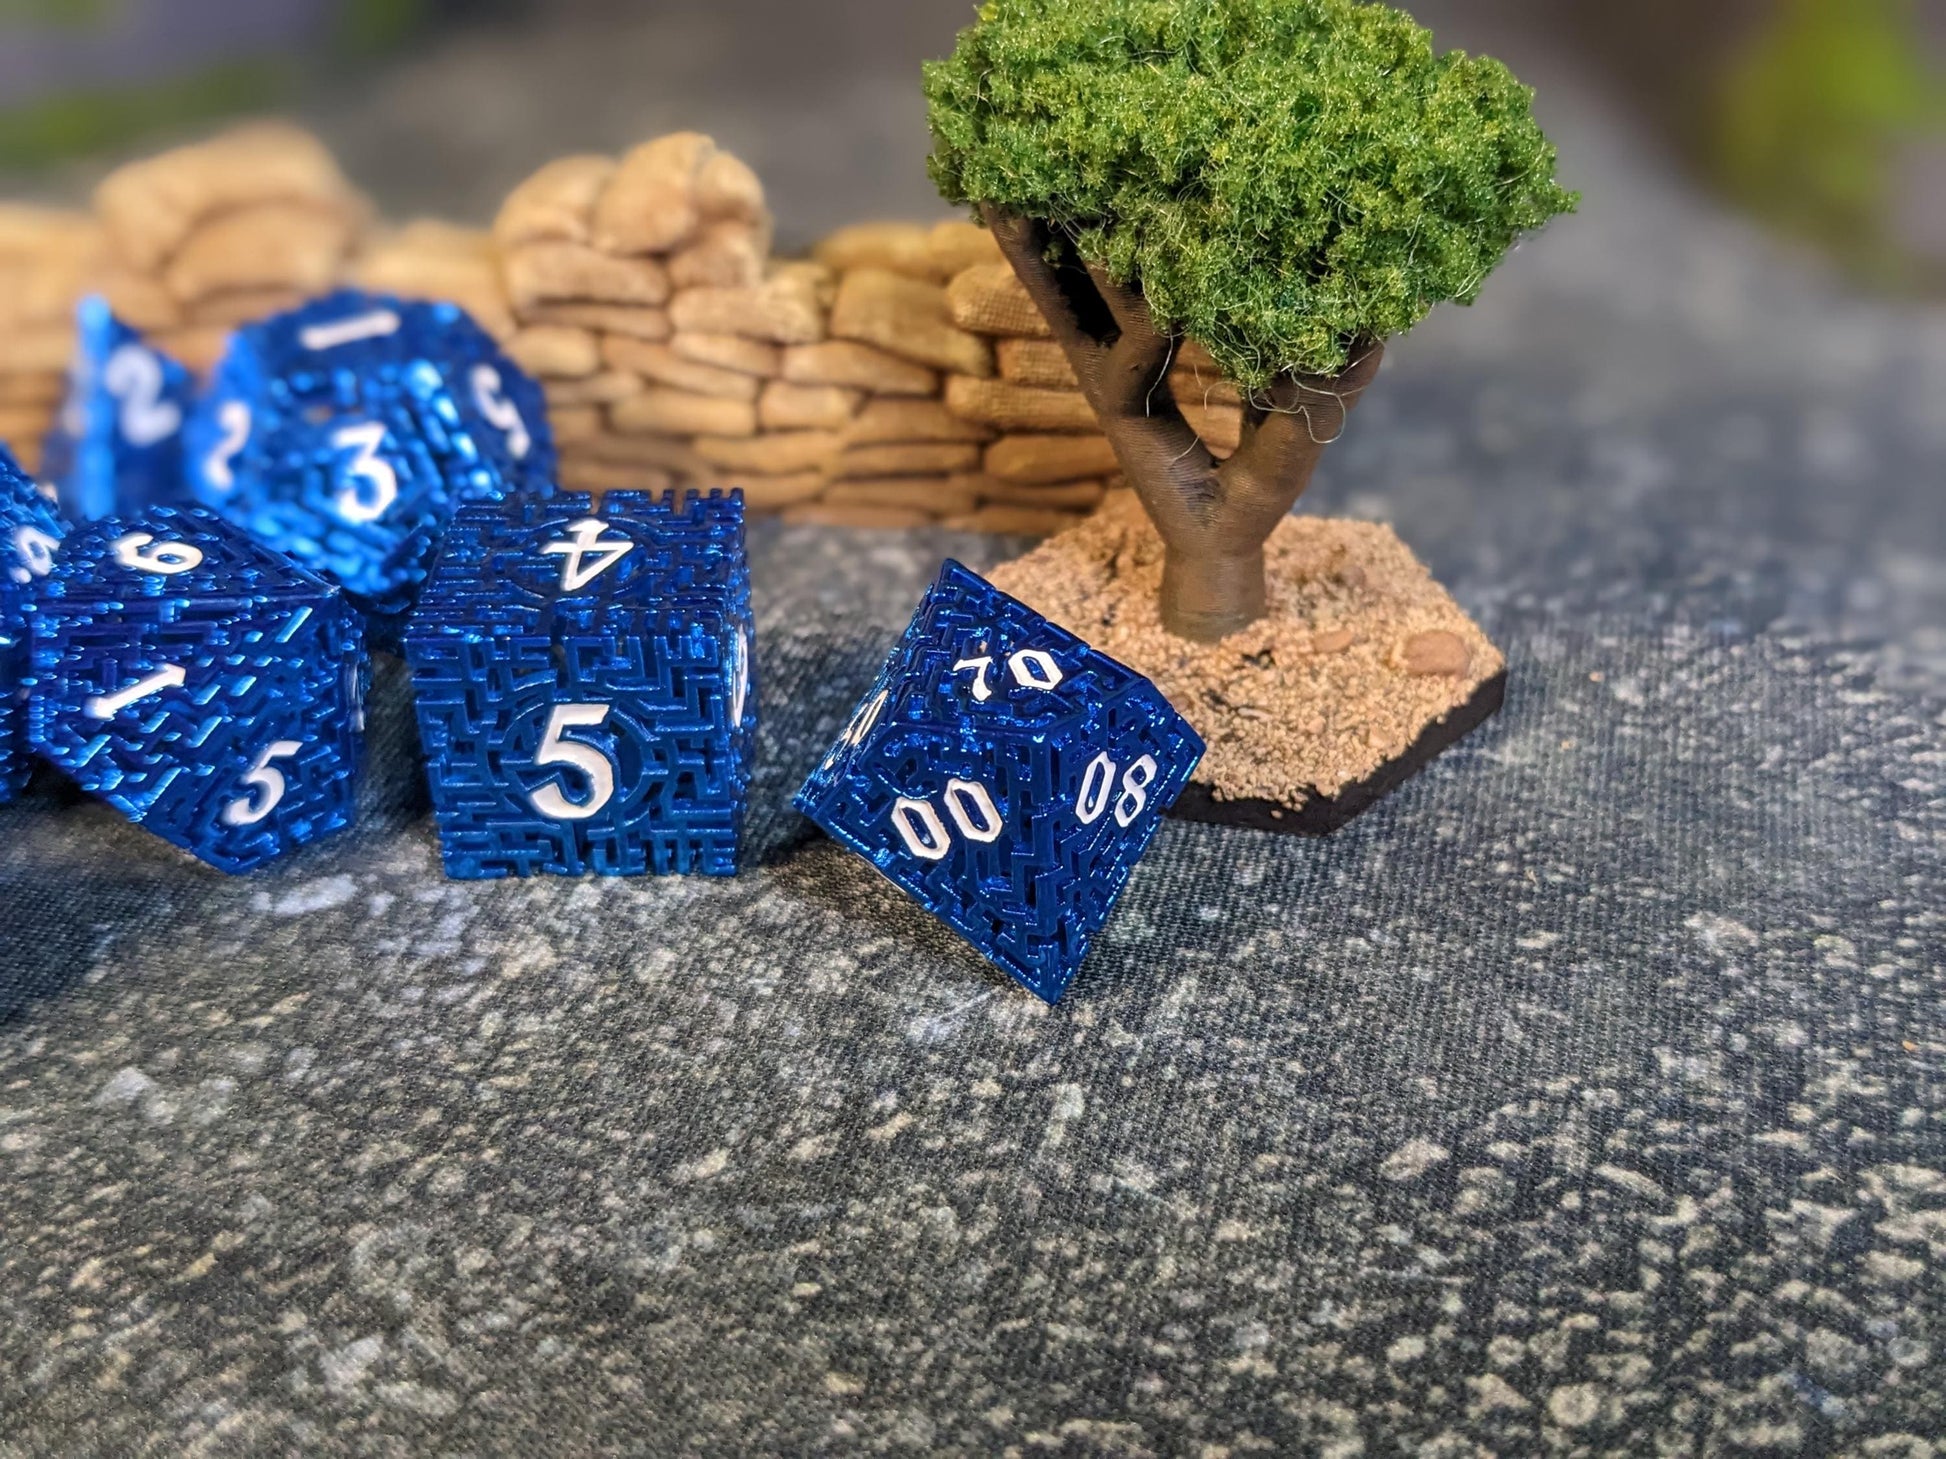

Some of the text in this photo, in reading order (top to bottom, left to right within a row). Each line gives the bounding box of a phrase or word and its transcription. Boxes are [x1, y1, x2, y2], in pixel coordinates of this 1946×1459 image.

[105, 343, 182, 443] 2
[332, 421, 398, 524] 3
[541, 518, 635, 592] 4
[90, 663, 186, 721] 1
[952, 648, 1064, 702] 70
[226, 740, 303, 826] 5
[531, 703, 614, 819] 5
[890, 777, 1003, 861] 00
